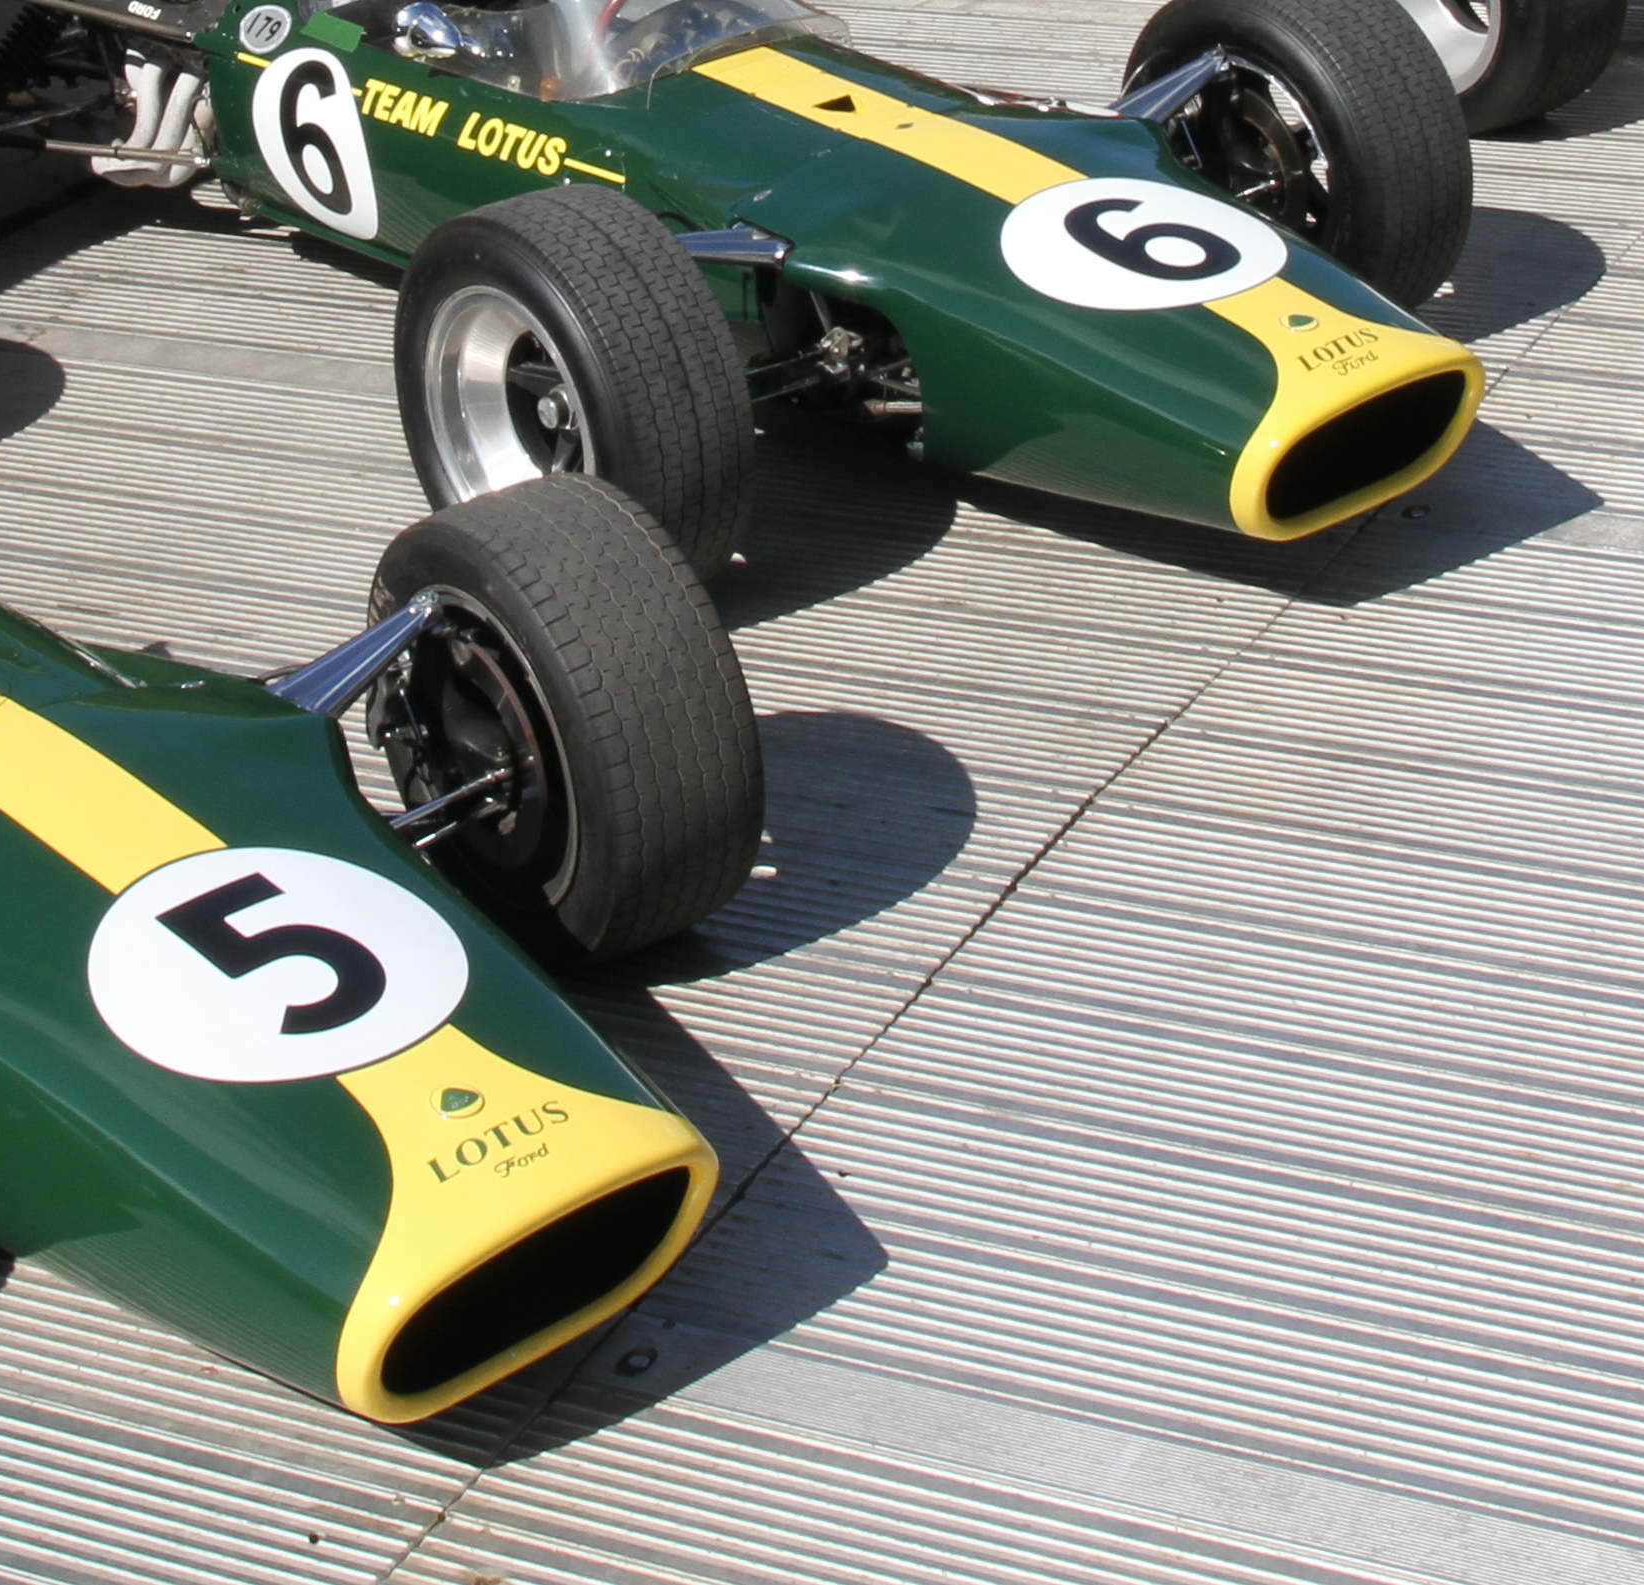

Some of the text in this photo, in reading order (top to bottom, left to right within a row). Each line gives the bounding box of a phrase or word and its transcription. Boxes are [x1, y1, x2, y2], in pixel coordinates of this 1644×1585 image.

[127, 0, 162, 21] FORD
[246, 12, 282, 42] 179
[279, 59, 353, 216] 6
[361, 77, 568, 176] TEAM LOTUS
[1063, 198, 1242, 281] 6
[1297, 327, 1379, 372] LOTUS
[1331, 349, 1379, 376] Ford
[154, 871, 387, 1036] 5
[427, 1100, 570, 1184] LOTUS
[494, 1141, 550, 1179] Ford
